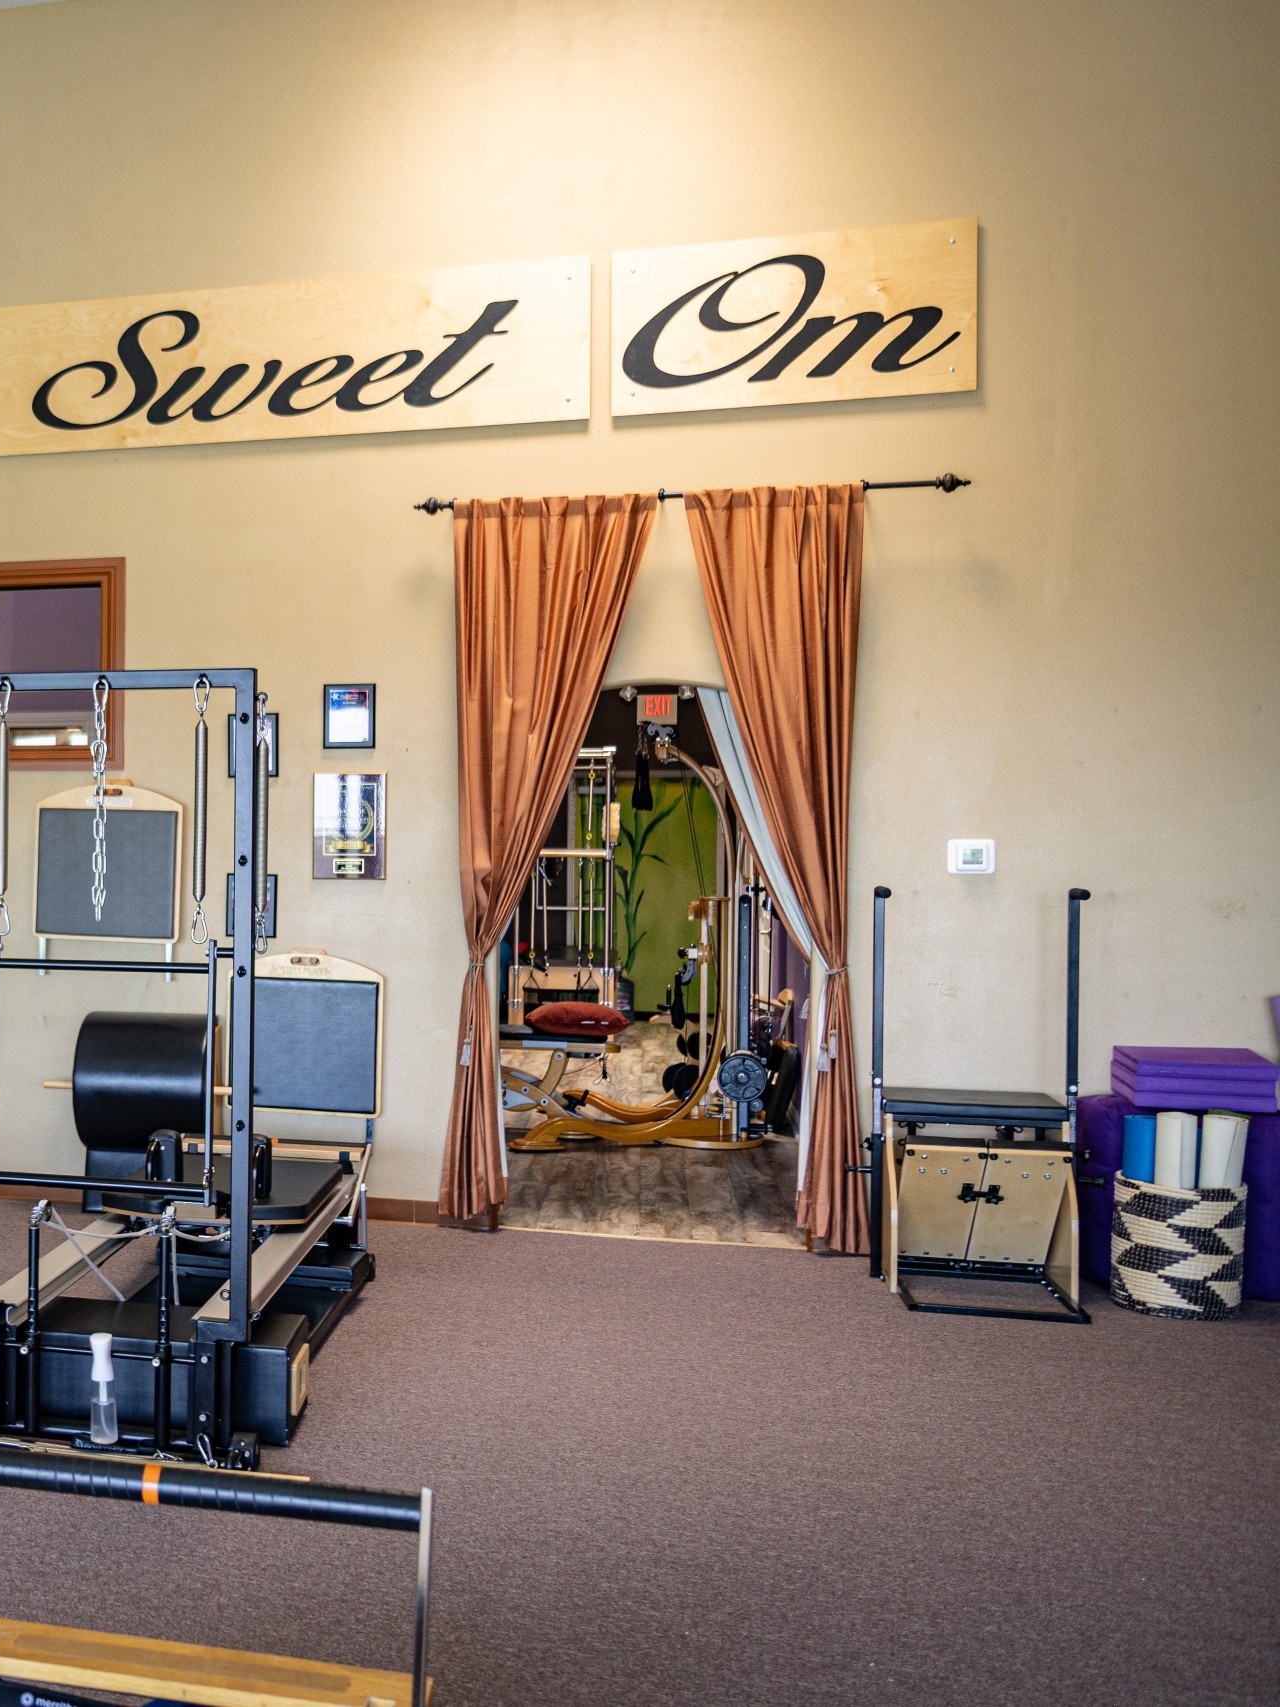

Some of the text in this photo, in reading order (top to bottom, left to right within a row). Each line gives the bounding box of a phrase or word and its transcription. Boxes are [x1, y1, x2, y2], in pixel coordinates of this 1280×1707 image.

[32, 299, 519, 430] Sweet
[622, 254, 961, 389] Om
[645, 695, 672, 716] EXIT
